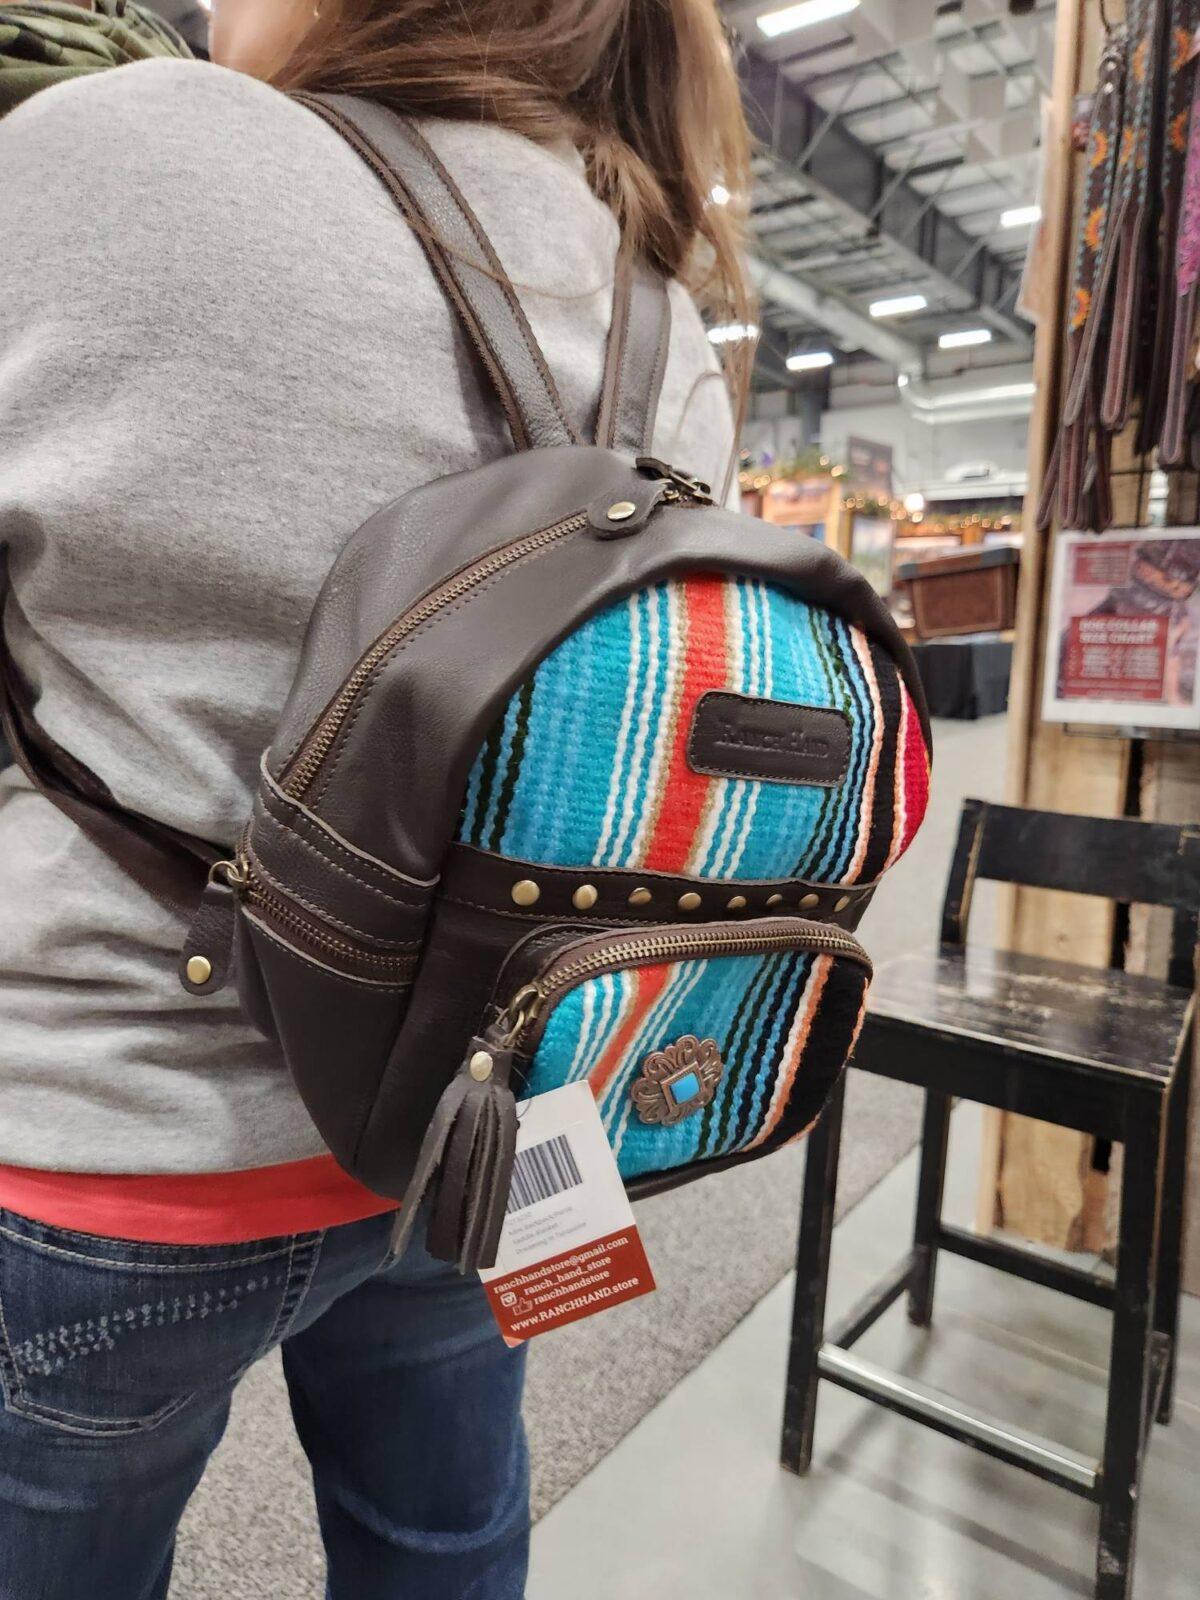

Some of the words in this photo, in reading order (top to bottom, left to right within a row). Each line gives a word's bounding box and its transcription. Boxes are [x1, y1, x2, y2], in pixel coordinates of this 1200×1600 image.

[493, 1236, 629, 1294] ranchhandstore@gmail.com
[523, 1256, 612, 1296] ranch_hand_store
[533, 1270, 610, 1305] ranchhandstore
[510, 1277, 639, 1331] www.RANCHHAND.store
